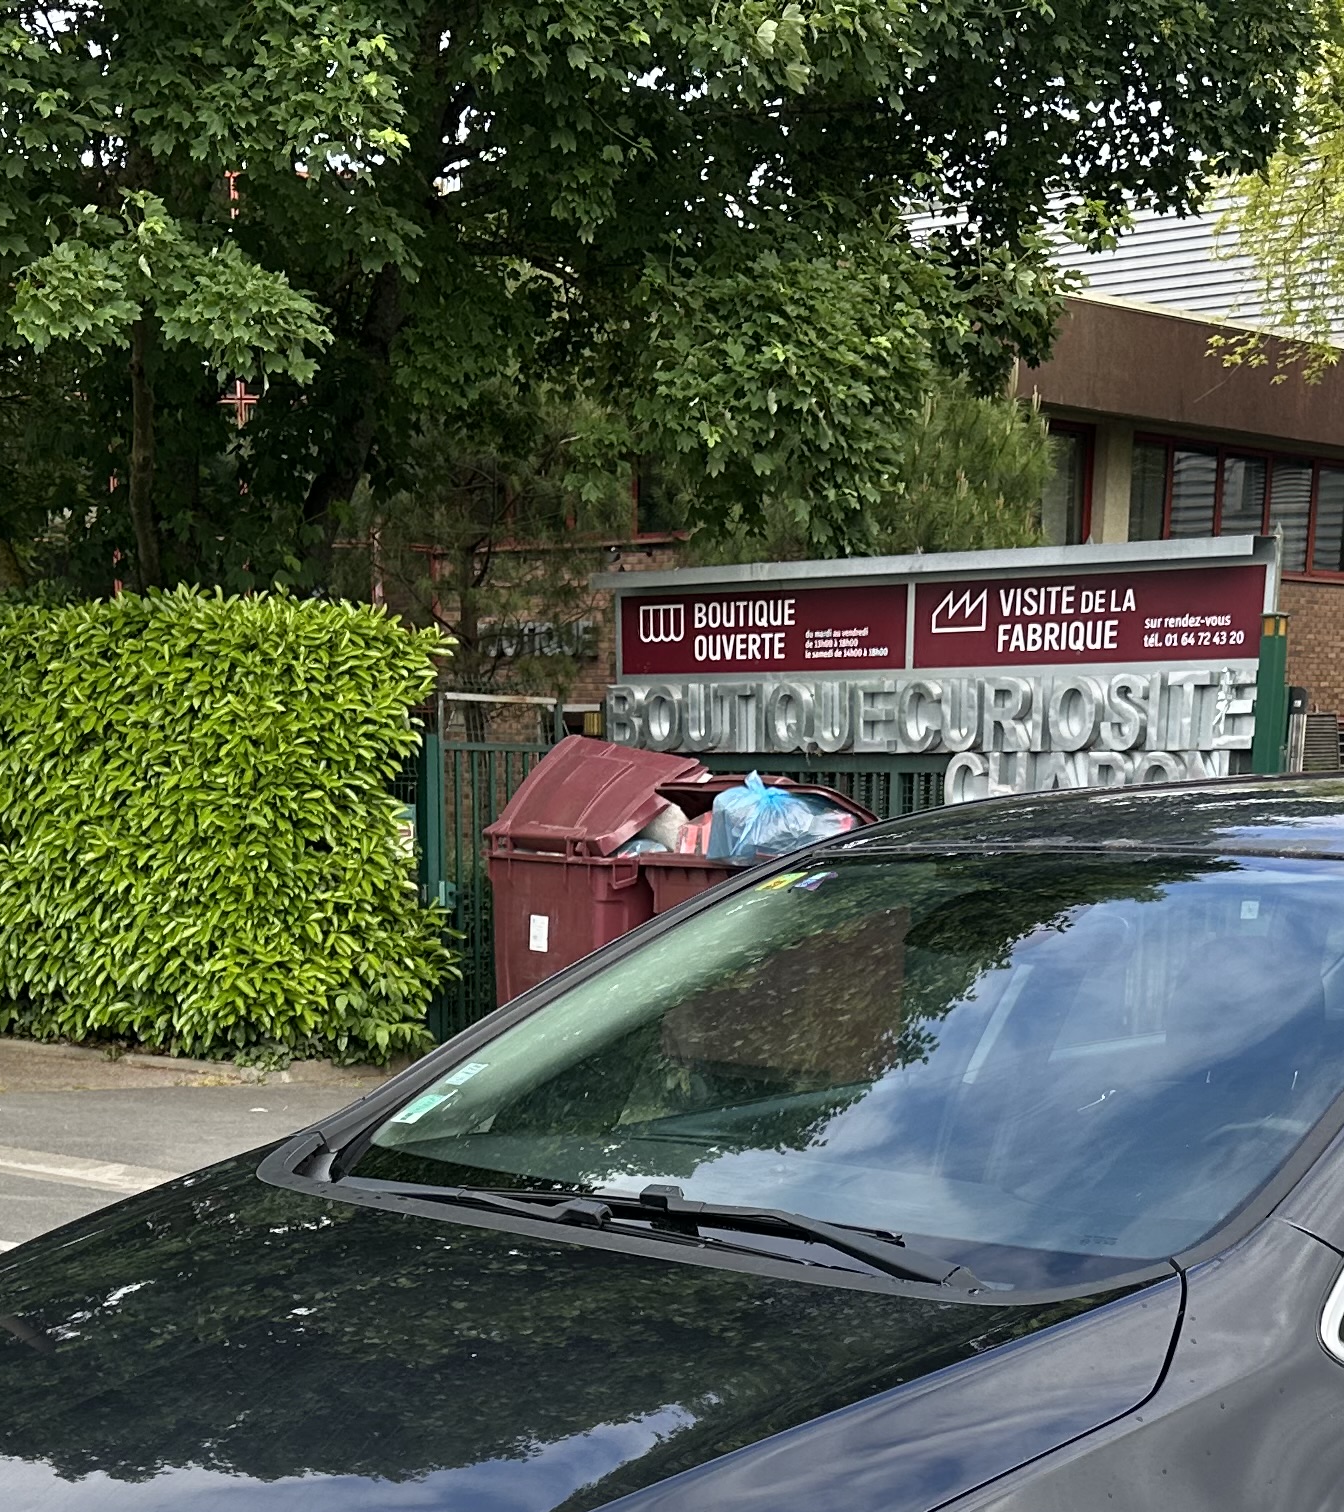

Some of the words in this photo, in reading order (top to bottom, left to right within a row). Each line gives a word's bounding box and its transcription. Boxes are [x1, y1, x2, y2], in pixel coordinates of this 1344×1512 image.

[693, 598, 796, 628] BOUTIQUE
[999, 586, 1075, 617] VISITE
[1080, 590, 1106, 614] DE
[1110, 588, 1136, 613] LA
[997, 619, 1119, 653] FABRIQUE
[1144, 616, 1163, 630] sur
[1164, 613, 1231, 629] rendez-vous
[693, 632, 786, 662] OUVERTE
[1143, 631, 1163, 648] tél.
[1164, 632, 1179, 647] 01
[1181, 632, 1196, 647] 64
[1198, 632, 1212, 646] 72
[1213, 631, 1227, 645] 43
[1229, 630, 1245, 645] 20
